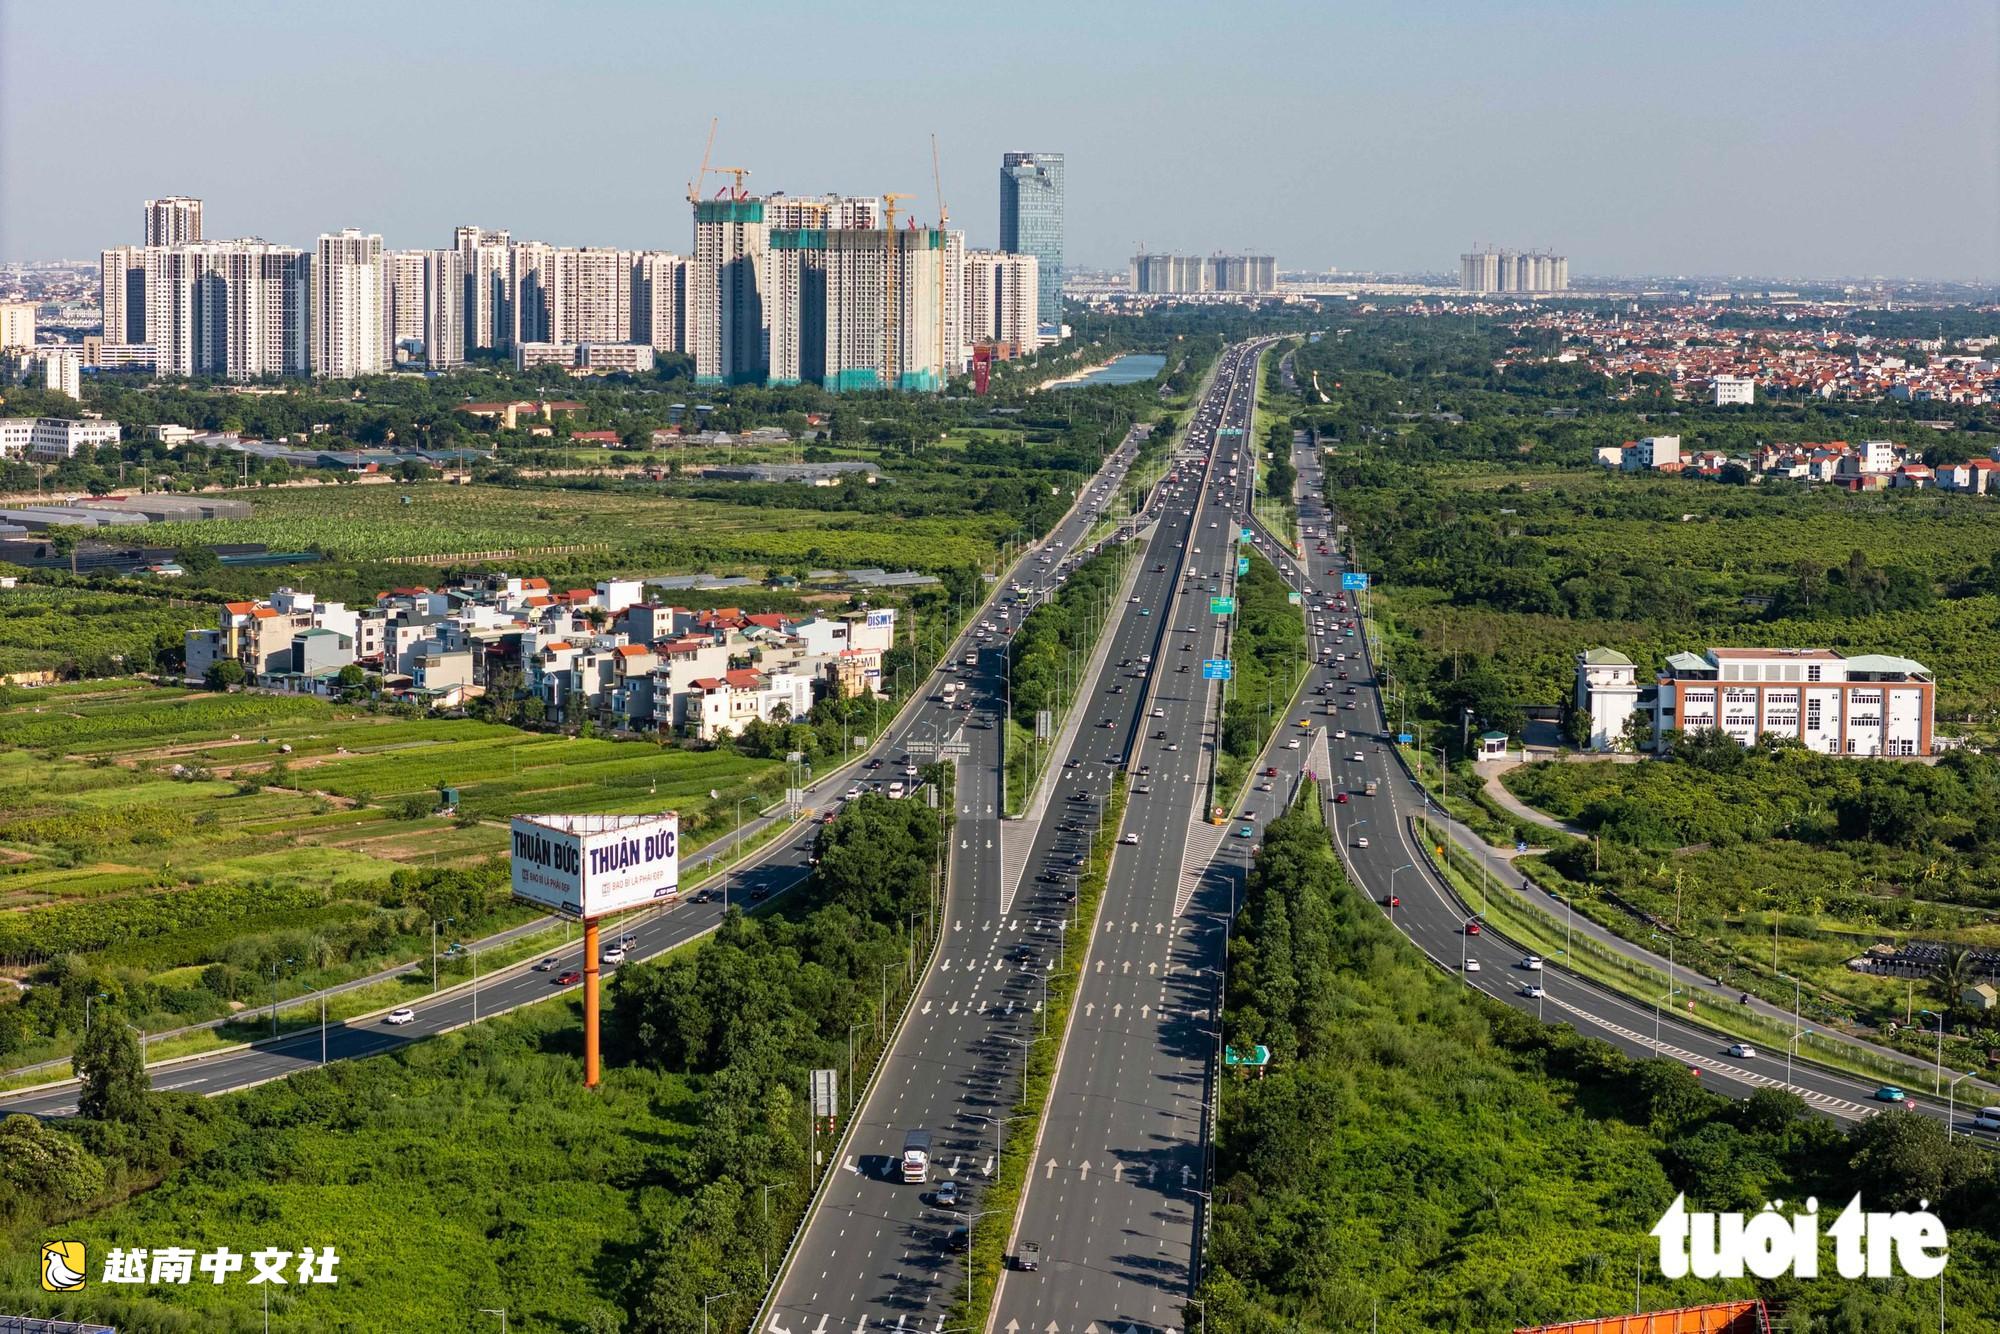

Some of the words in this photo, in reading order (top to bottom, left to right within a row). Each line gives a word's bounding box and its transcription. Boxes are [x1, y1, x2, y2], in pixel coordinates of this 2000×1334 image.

[513, 830, 551, 870] THUẬN
[553, 840, 579, 876] ĐỨC
[590, 836, 640, 875] THUẬN
[644, 828, 675, 862] ĐỨC
